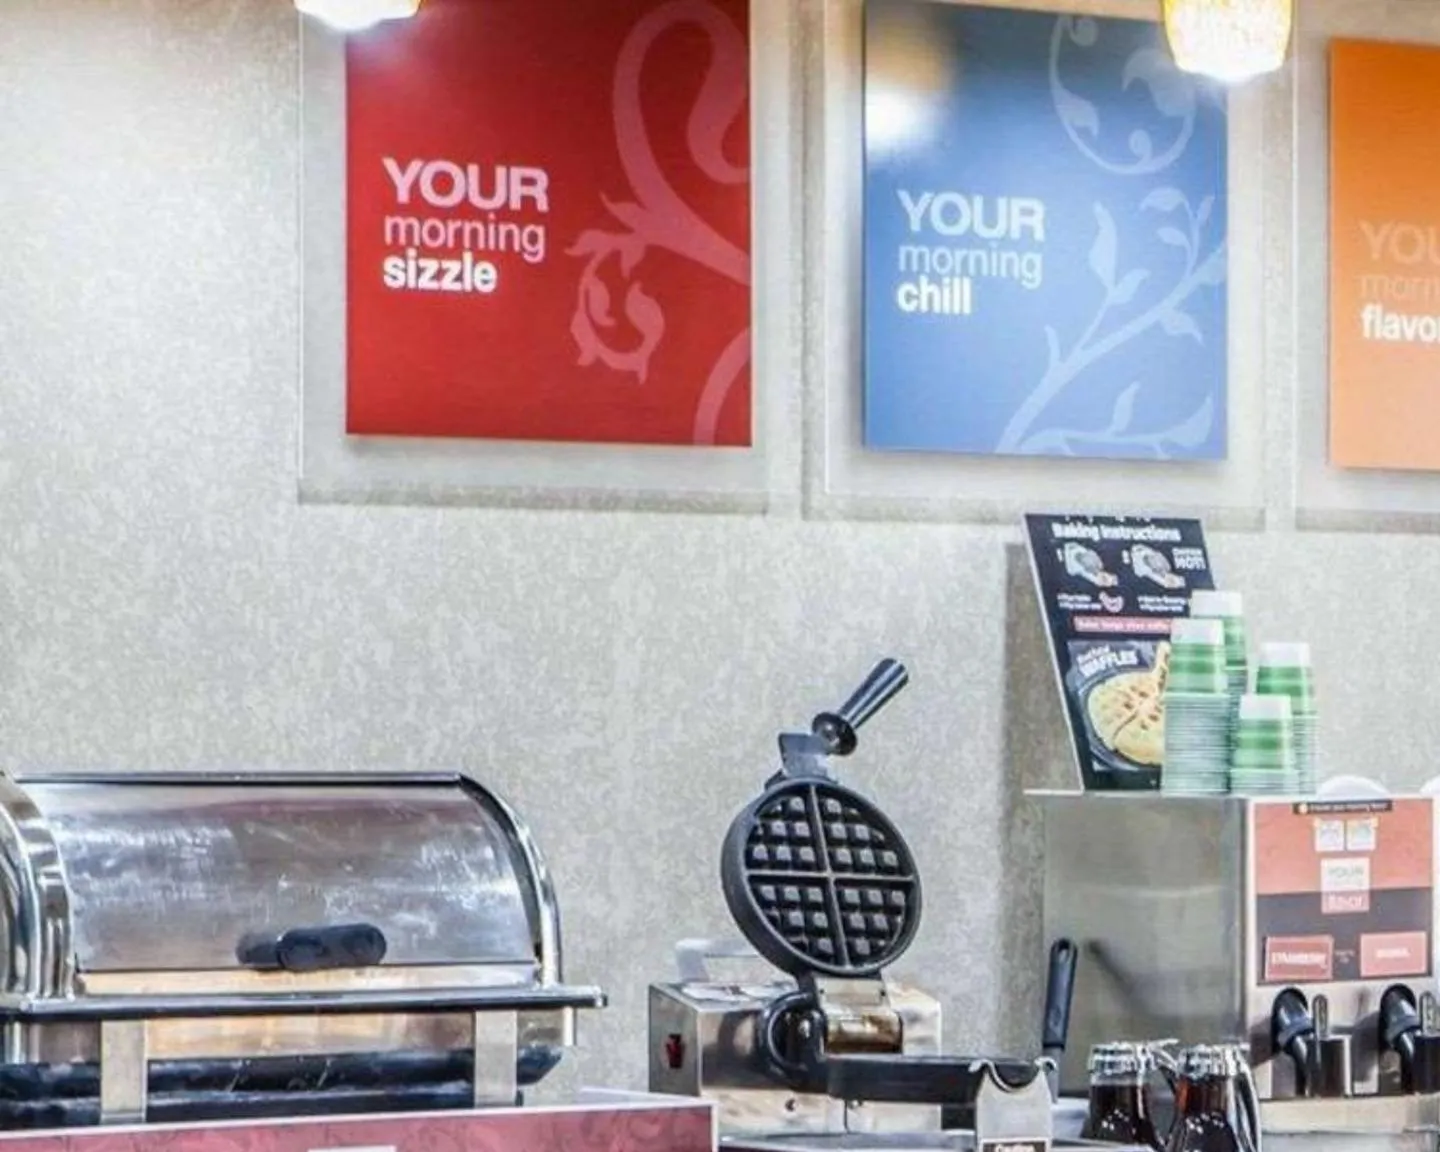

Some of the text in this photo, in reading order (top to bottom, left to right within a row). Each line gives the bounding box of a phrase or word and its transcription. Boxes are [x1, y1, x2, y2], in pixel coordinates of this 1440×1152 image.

[382, 157, 549, 212] YOUR
[384, 213, 545, 263] morning
[897, 189, 1045, 242] YOUR
[383, 248, 497, 293] sizzle
[899, 241, 1042, 290] morning
[897, 274, 971, 315] chill
[1051, 521, 1099, 542] Baking
